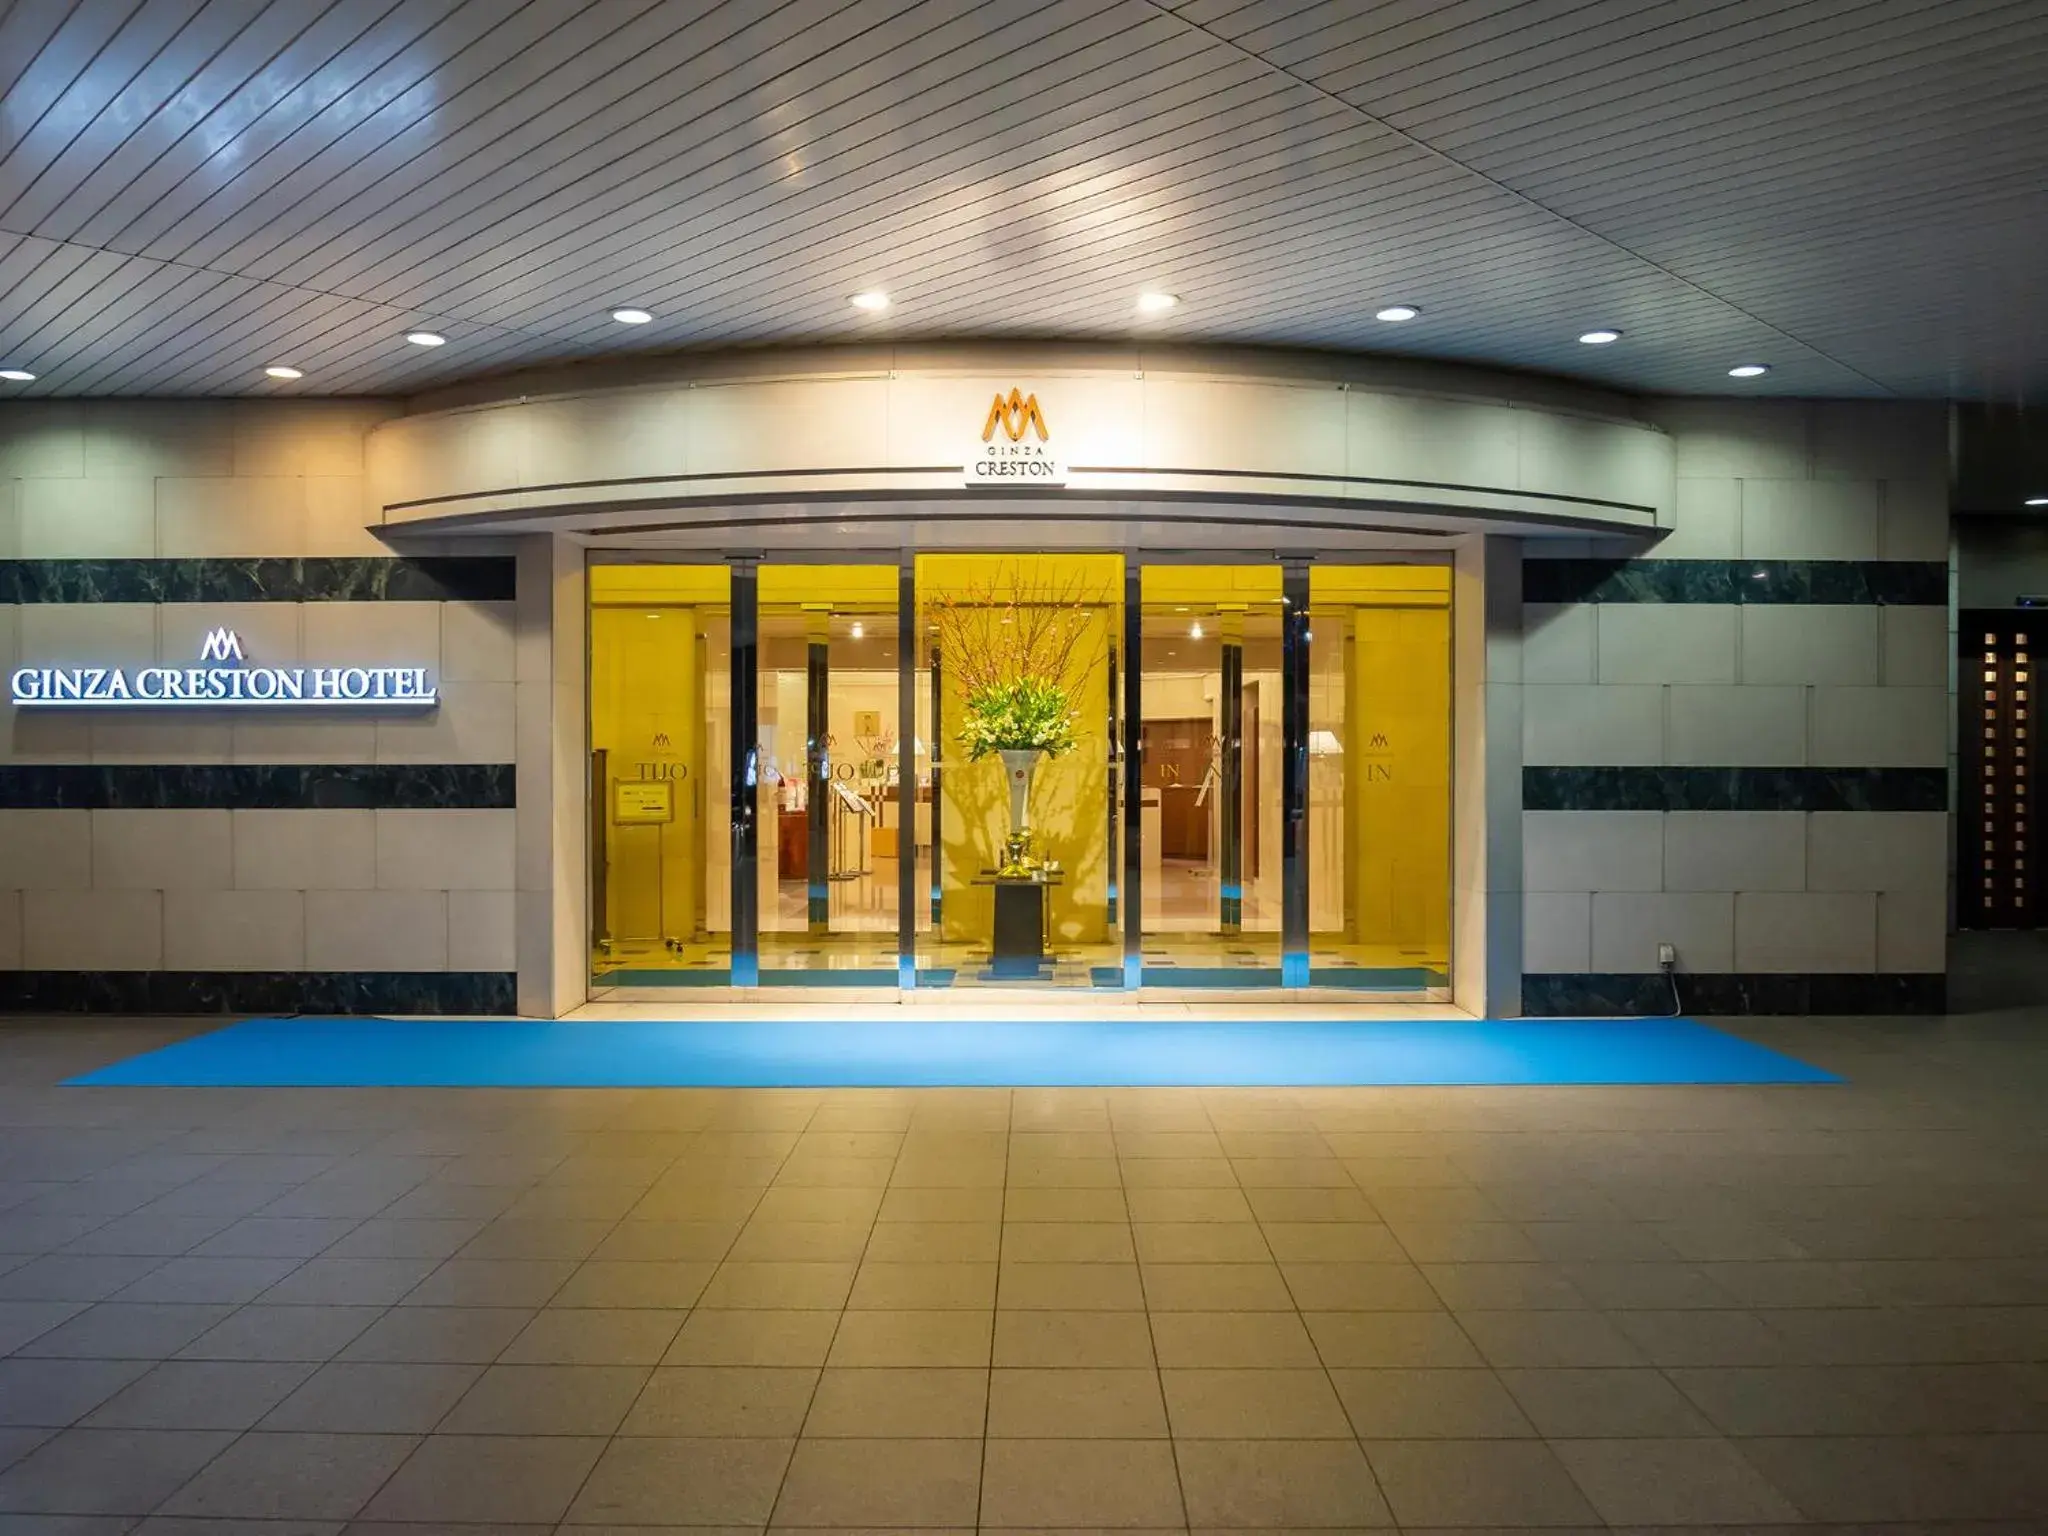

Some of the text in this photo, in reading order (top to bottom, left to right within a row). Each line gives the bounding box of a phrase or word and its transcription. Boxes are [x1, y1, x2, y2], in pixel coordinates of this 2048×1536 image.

[987, 446, 1043, 456] GINZA
[975, 460, 1055, 476] CRESTON
[11, 668, 437, 699] GINZA CRESTON HOTEL
[1160, 763, 1181, 779] IN
[1366, 763, 1393, 782] IN
